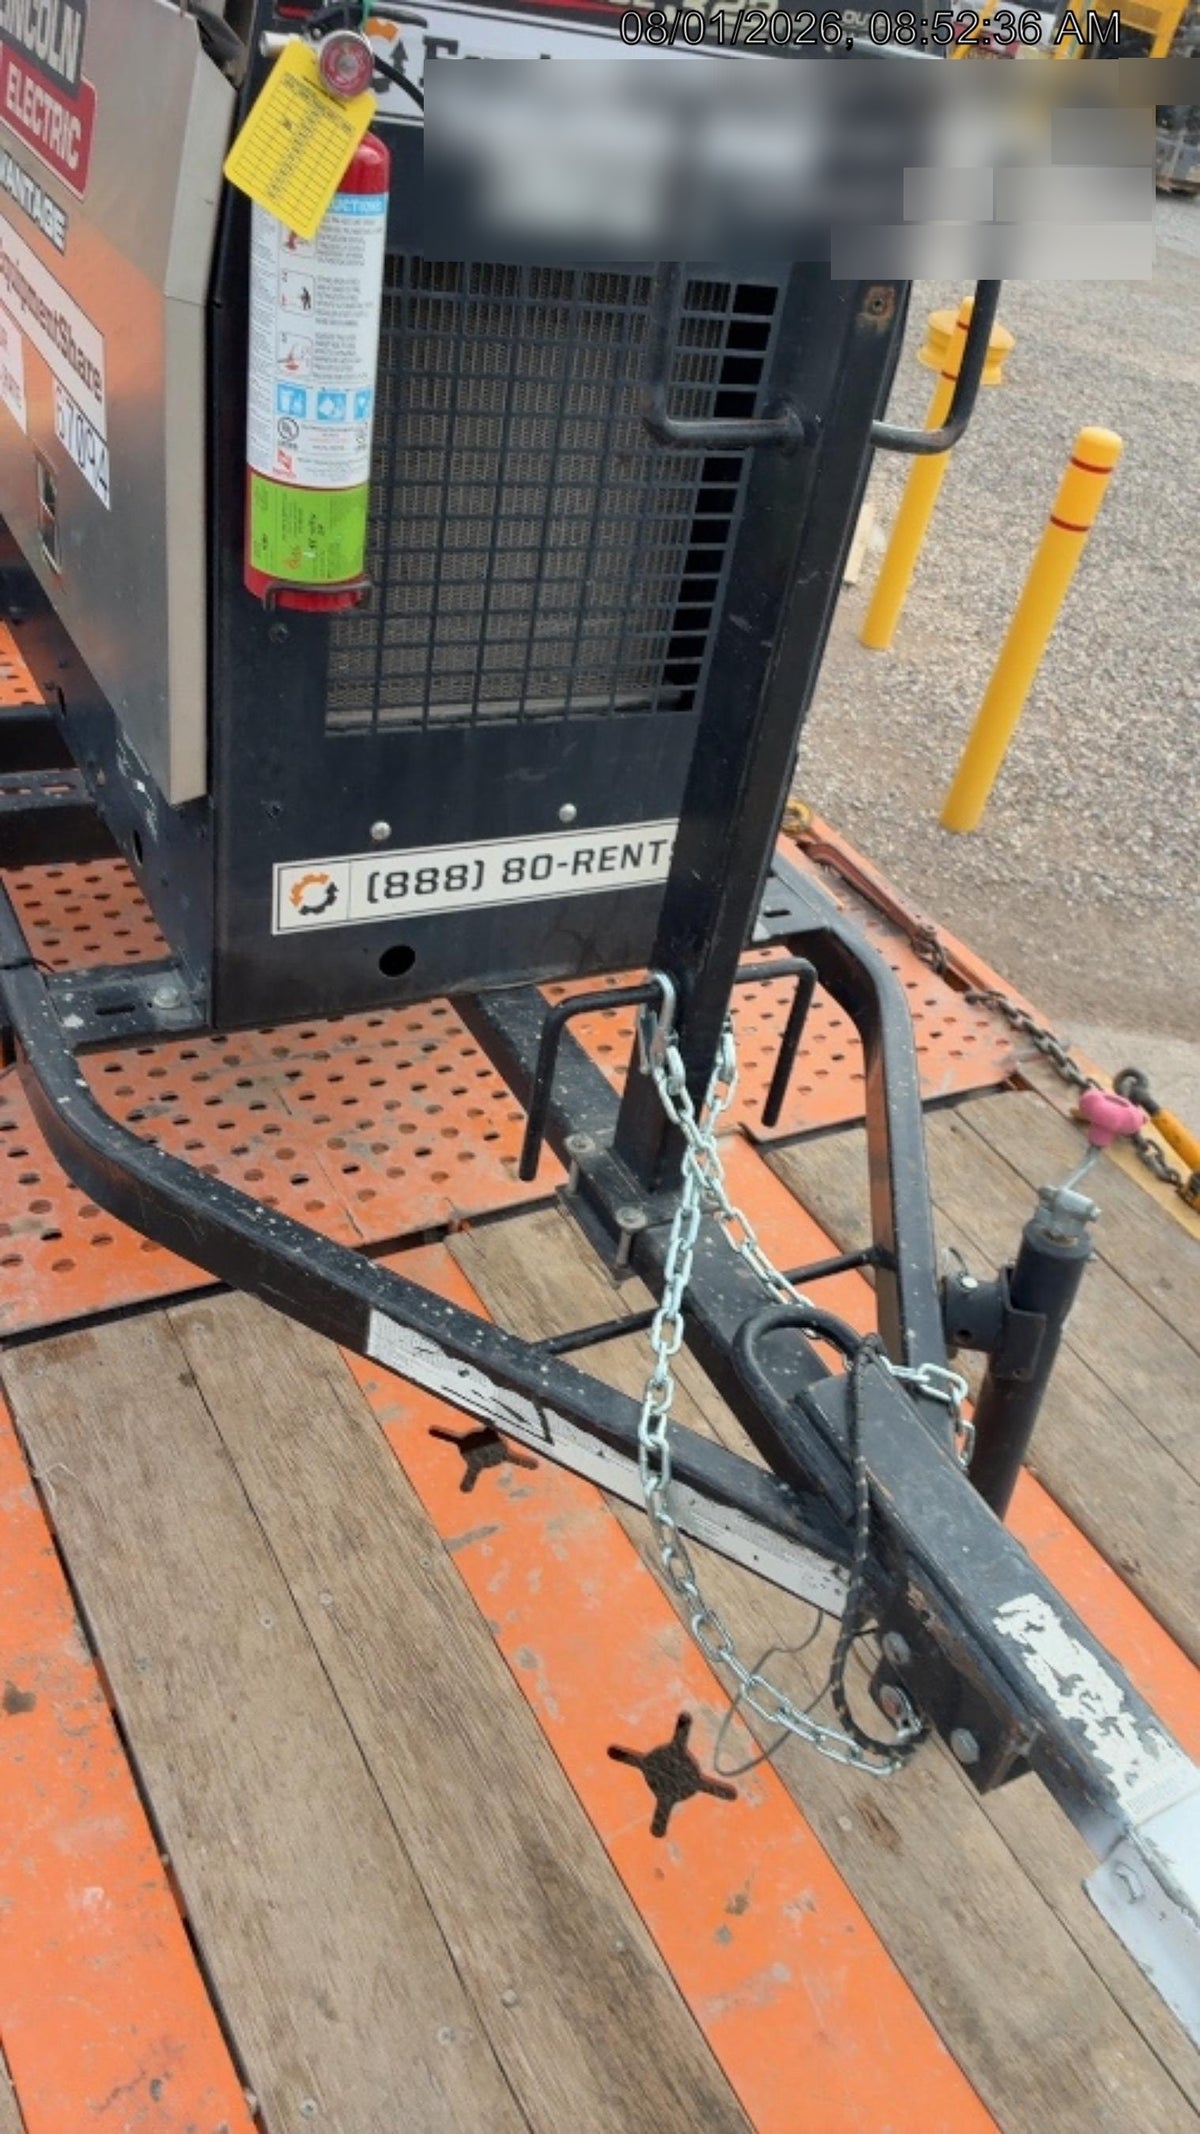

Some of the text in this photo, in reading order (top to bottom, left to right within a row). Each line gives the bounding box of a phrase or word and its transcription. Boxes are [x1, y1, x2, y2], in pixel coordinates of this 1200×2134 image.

[6, 62, 81, 170] ELECTRIC
[332, 197, 382, 213] UCTIONS
[367, 838, 674, 903] (888) 80-RENT
